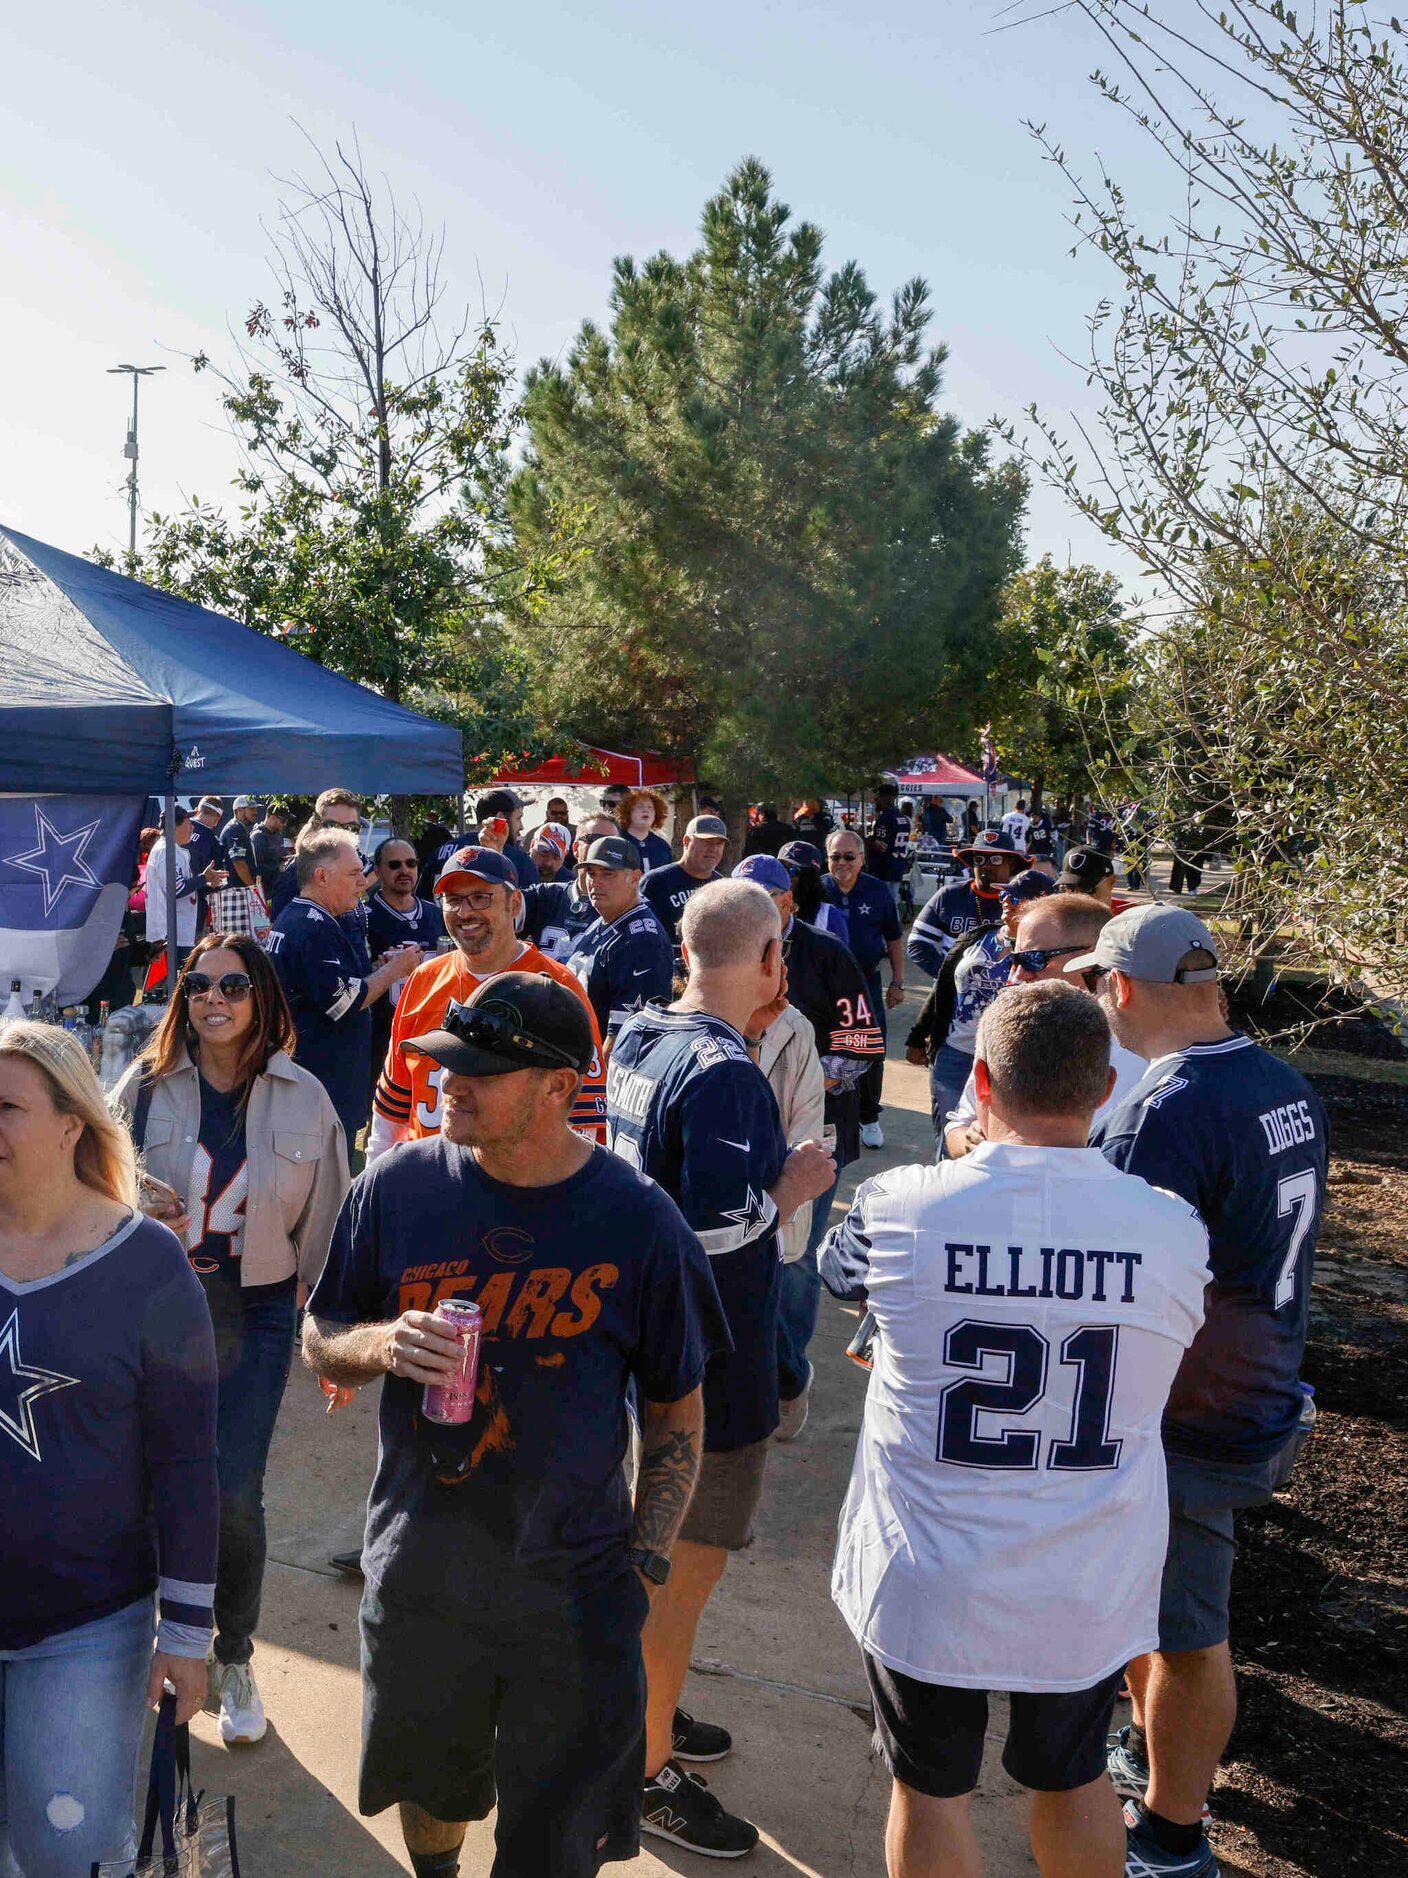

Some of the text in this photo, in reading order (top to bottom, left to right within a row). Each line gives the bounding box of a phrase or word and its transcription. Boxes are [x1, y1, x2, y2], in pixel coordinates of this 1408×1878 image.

[900, 784, 923, 792] GGIES
[1008, 824, 1023, 839] 14
[1033, 829, 1047, 841] 82
[836, 993, 872, 1027] 34
[690, 1035, 753, 1071] 22
[845, 1033, 868, 1048] GSH
[1259, 1100, 1316, 1156] DIGGS
[1273, 1167, 1318, 1311] 7
[402, 1259, 470, 1283] CHICAGO
[943, 1243, 1143, 1303] ELLIOTT
[935, 1318, 1124, 1471] 21
